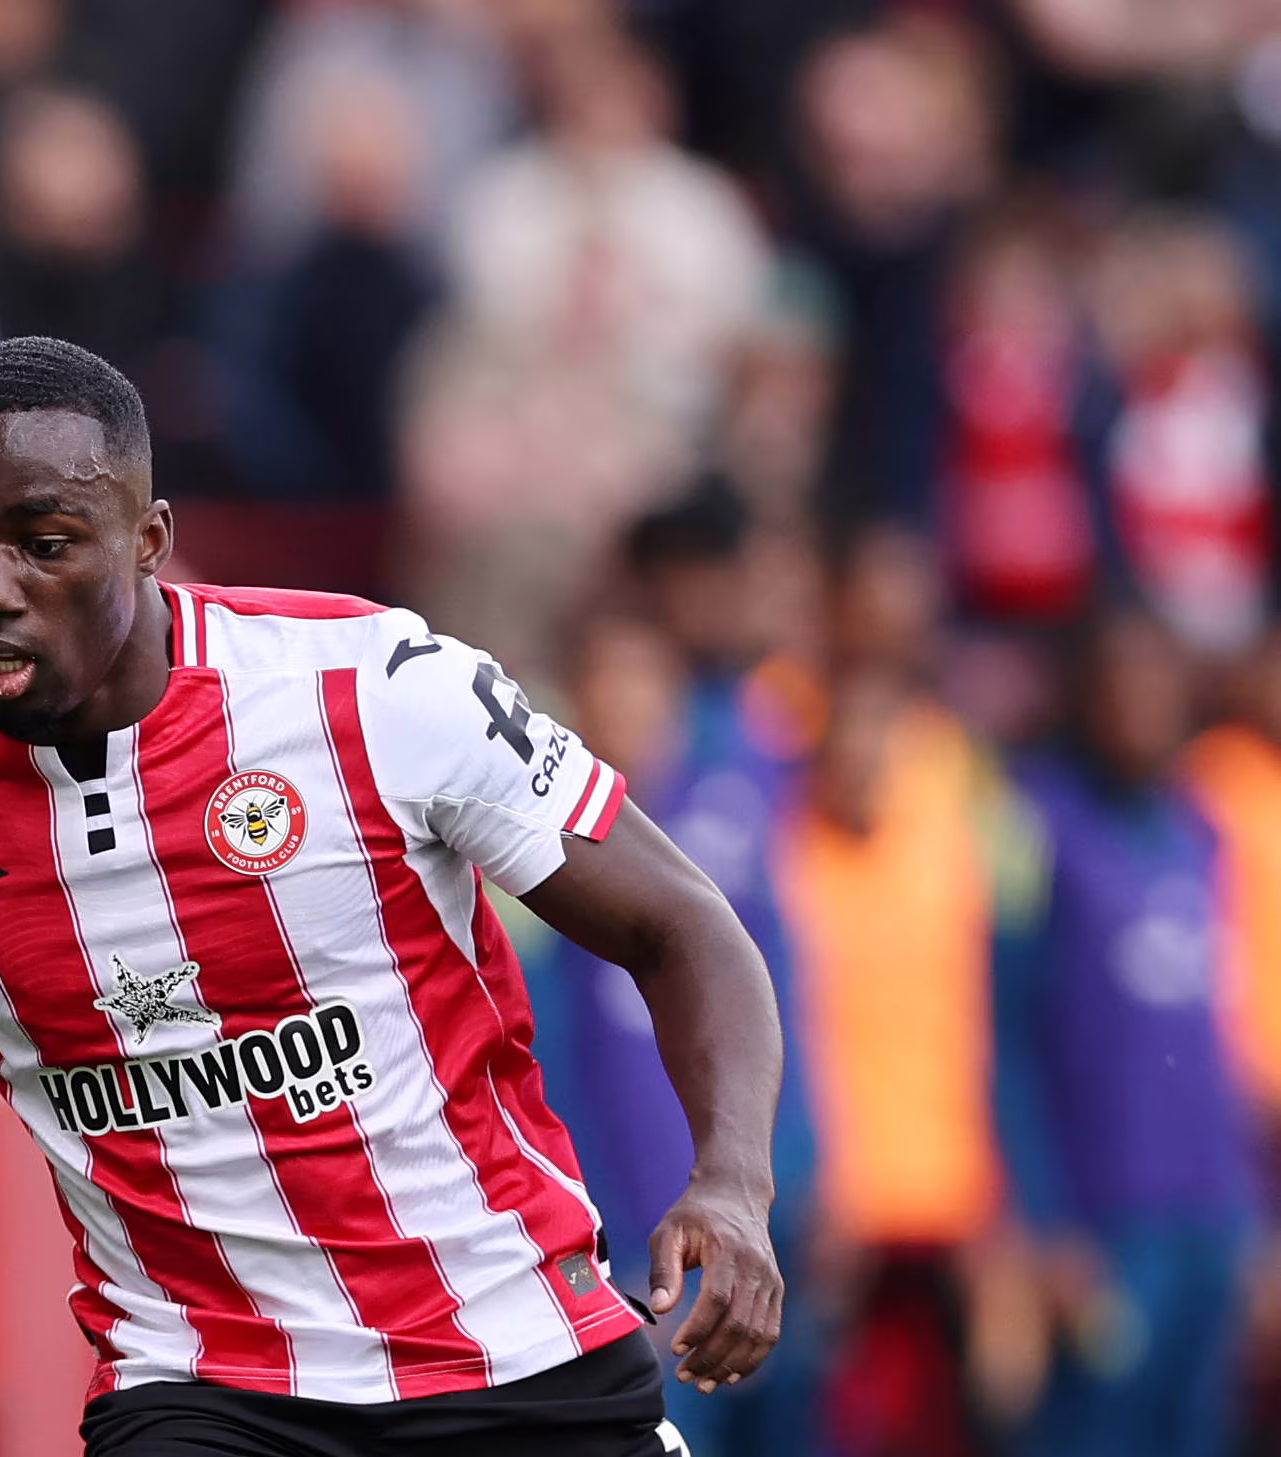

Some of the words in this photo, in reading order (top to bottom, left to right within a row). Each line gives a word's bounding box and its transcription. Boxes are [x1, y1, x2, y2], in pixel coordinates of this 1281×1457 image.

[213, 774, 286, 810] BRENTFORD
[226, 852, 278, 870] FOOTBALL
[278, 834, 300, 859] CLUB
[39, 1005, 362, 1133] HOLLYWOOD
[287, 1062, 373, 1119] bets
